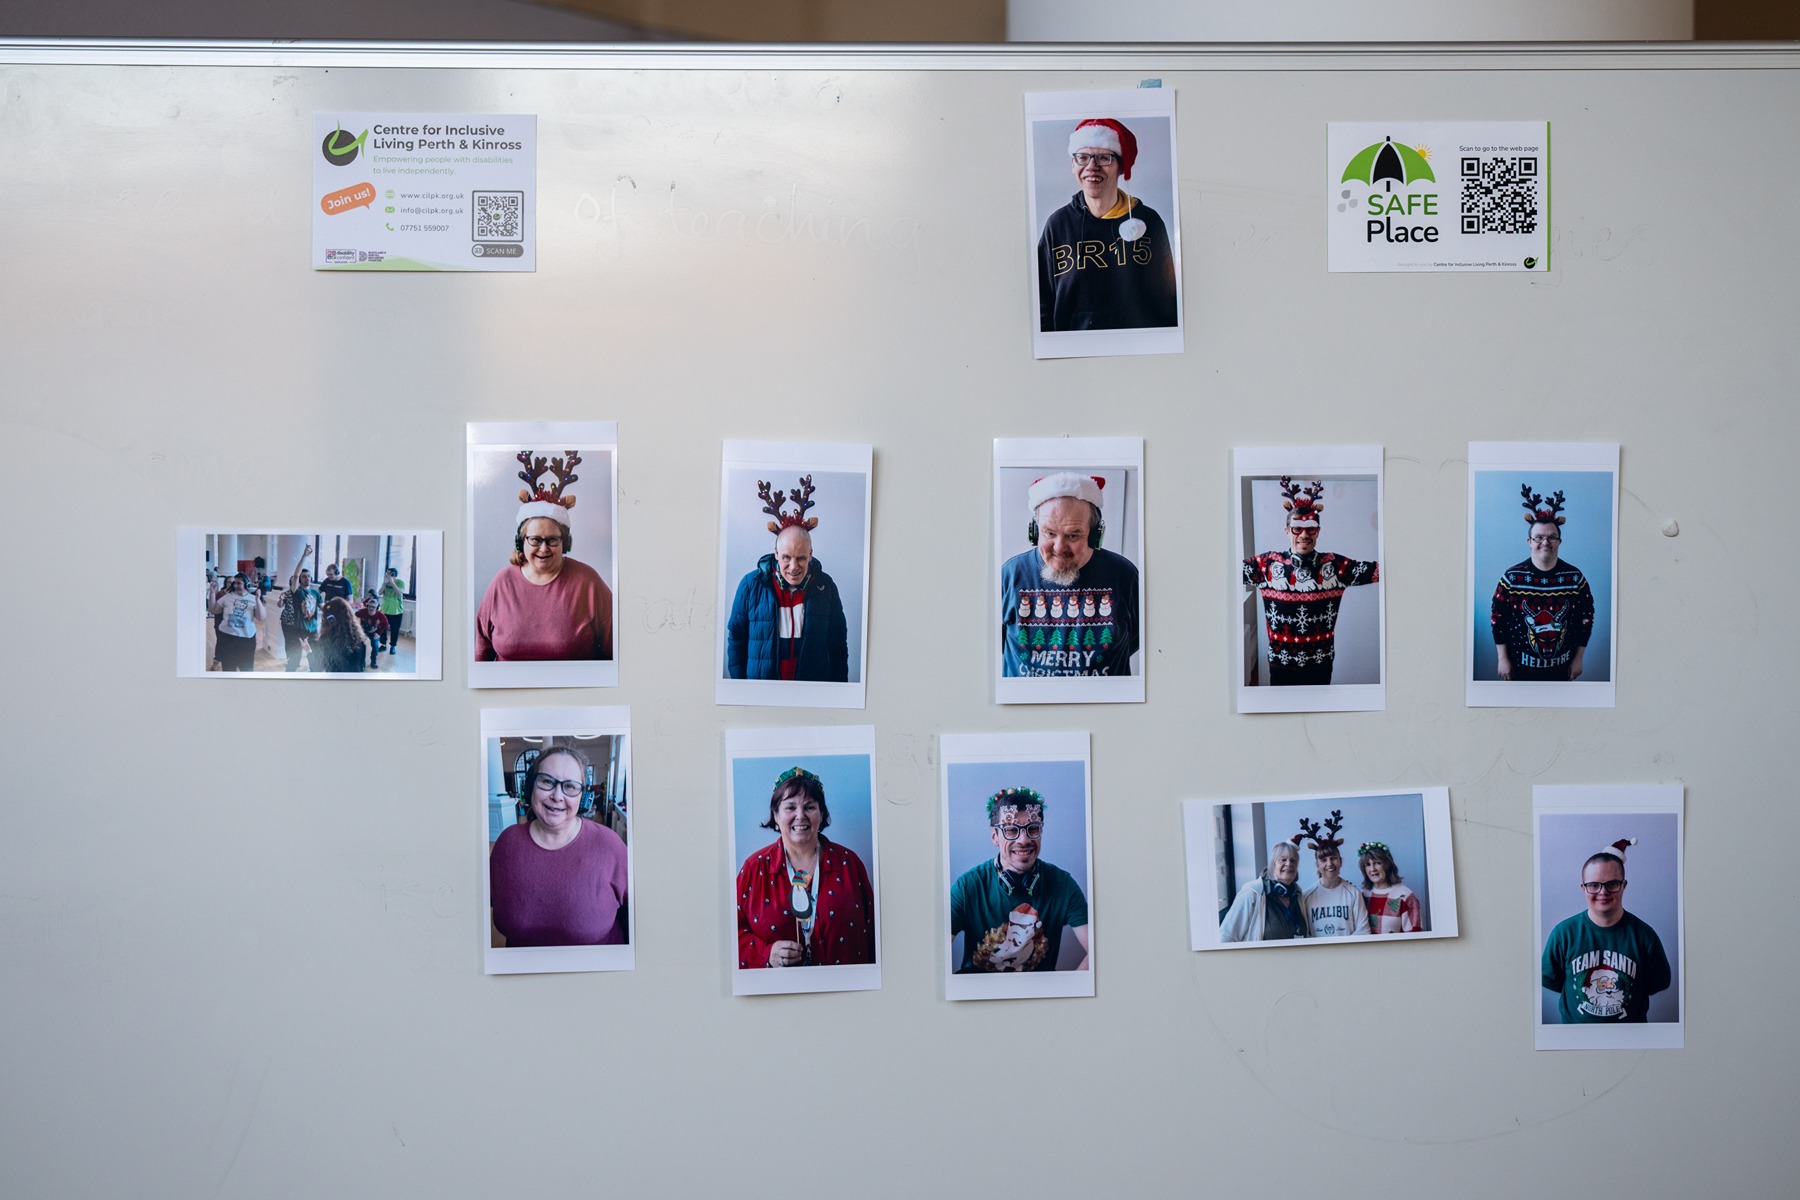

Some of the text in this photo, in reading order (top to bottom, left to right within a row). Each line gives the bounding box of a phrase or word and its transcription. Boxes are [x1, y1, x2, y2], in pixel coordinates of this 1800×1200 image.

[373, 124, 505, 136] Centre for Inclusive
[373, 138, 522, 151] Living Perth & Kinross
[373, 156, 424, 165] Empowering
[425, 156, 450, 165] people
[398, 167, 456, 176] independently.
[327, 188, 371, 210] Join us!
[1367, 193, 1439, 216] SAFE
[1366, 216, 1439, 243] Place
[1052, 236, 1153, 277] BR15
[1030, 650, 1096, 667] MERRY
[1521, 650, 1571, 668] HELLFIRE
[1311, 905, 1349, 923] MALIBU
[1571, 950, 1637, 980] TEAM SANTA
[1605, 1005, 1620, 1015] POLE
